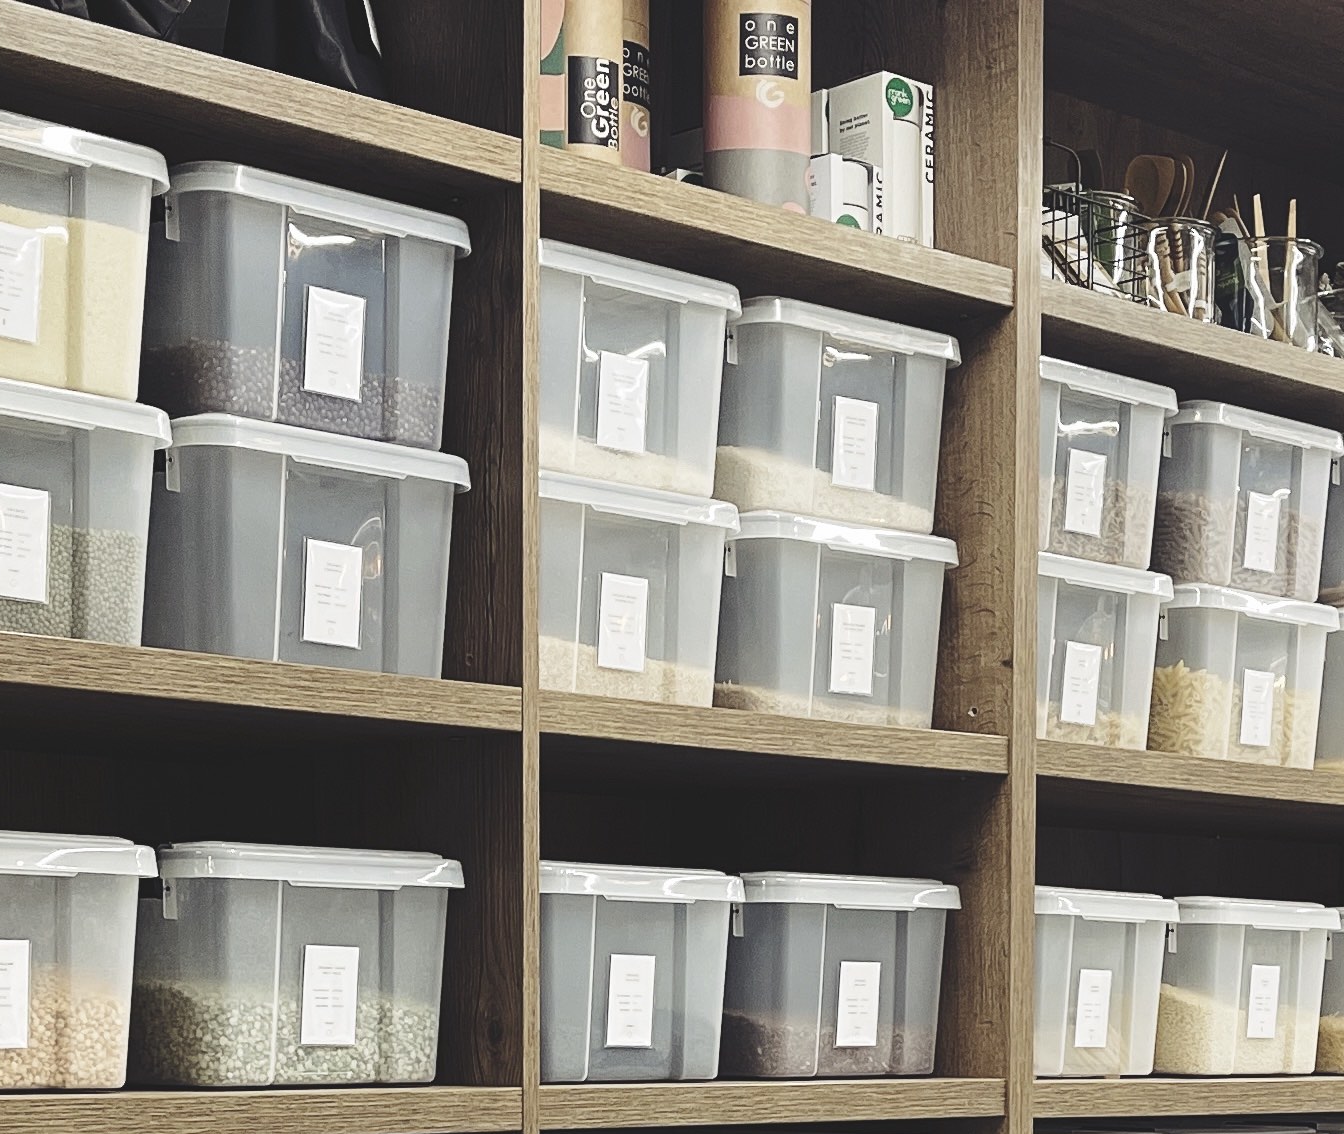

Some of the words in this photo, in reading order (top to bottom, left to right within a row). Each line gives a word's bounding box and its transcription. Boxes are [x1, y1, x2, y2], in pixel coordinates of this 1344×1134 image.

[744, 19, 795, 35] one
[744, 36, 795, 53] GREEN
[744, 54, 795, 72] bottle
[580, 78, 596, 118] One
[591, 58, 610, 138] Green
[607, 97, 619, 150] Bottle
[924, 90, 934, 184] CERAMIC
